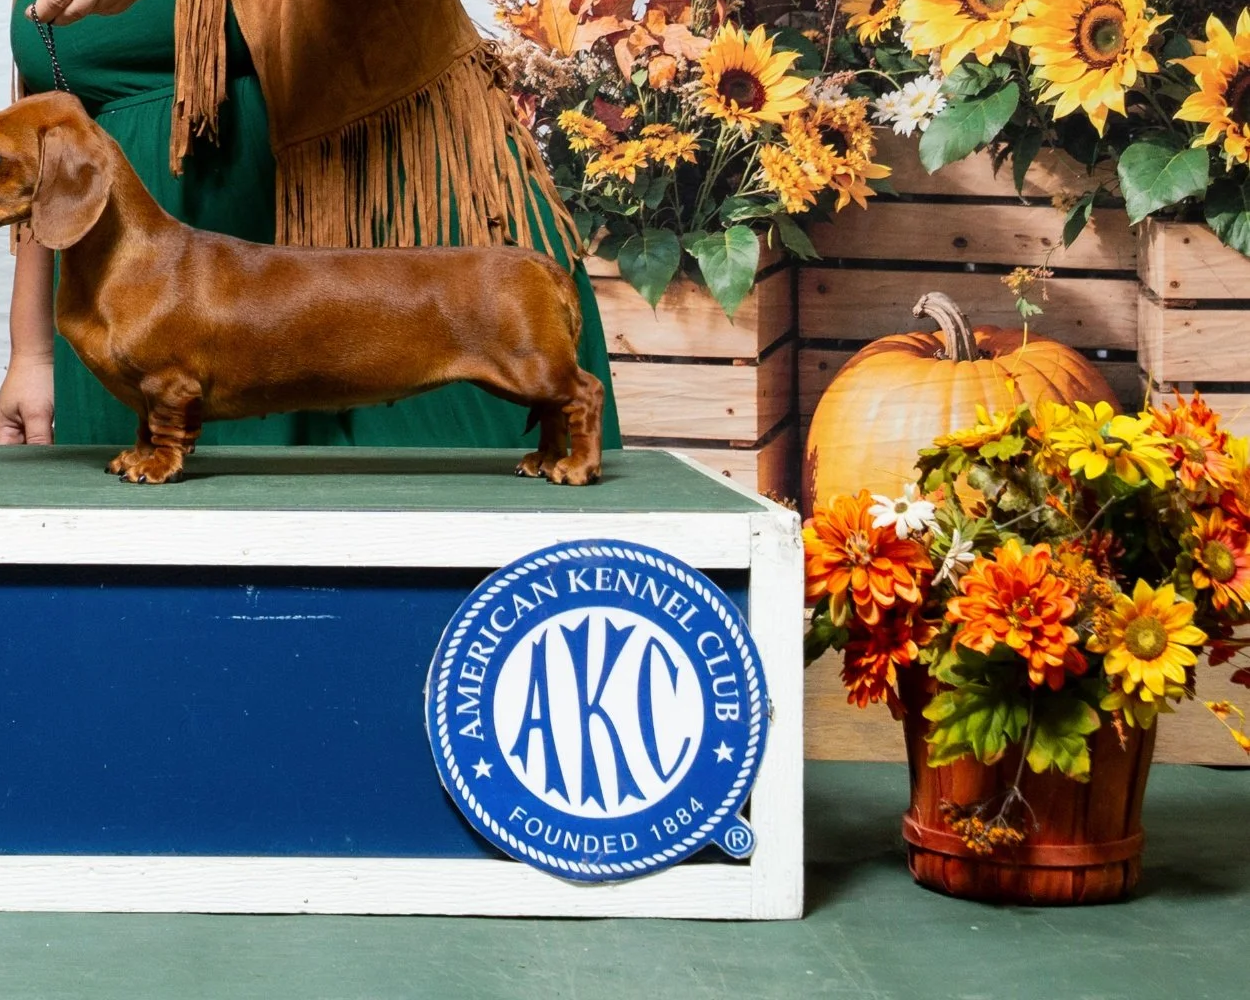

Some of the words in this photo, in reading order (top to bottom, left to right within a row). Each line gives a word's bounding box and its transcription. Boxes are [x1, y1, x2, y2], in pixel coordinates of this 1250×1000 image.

[456, 577, 559, 742] AMERICAN
[566, 567, 700, 632] KENNEL
[697, 631, 740, 722] CLUB
[509, 613, 691, 814] AKC
[508, 806, 638, 854] FOUNDED
[650, 796, 704, 841] 1884
